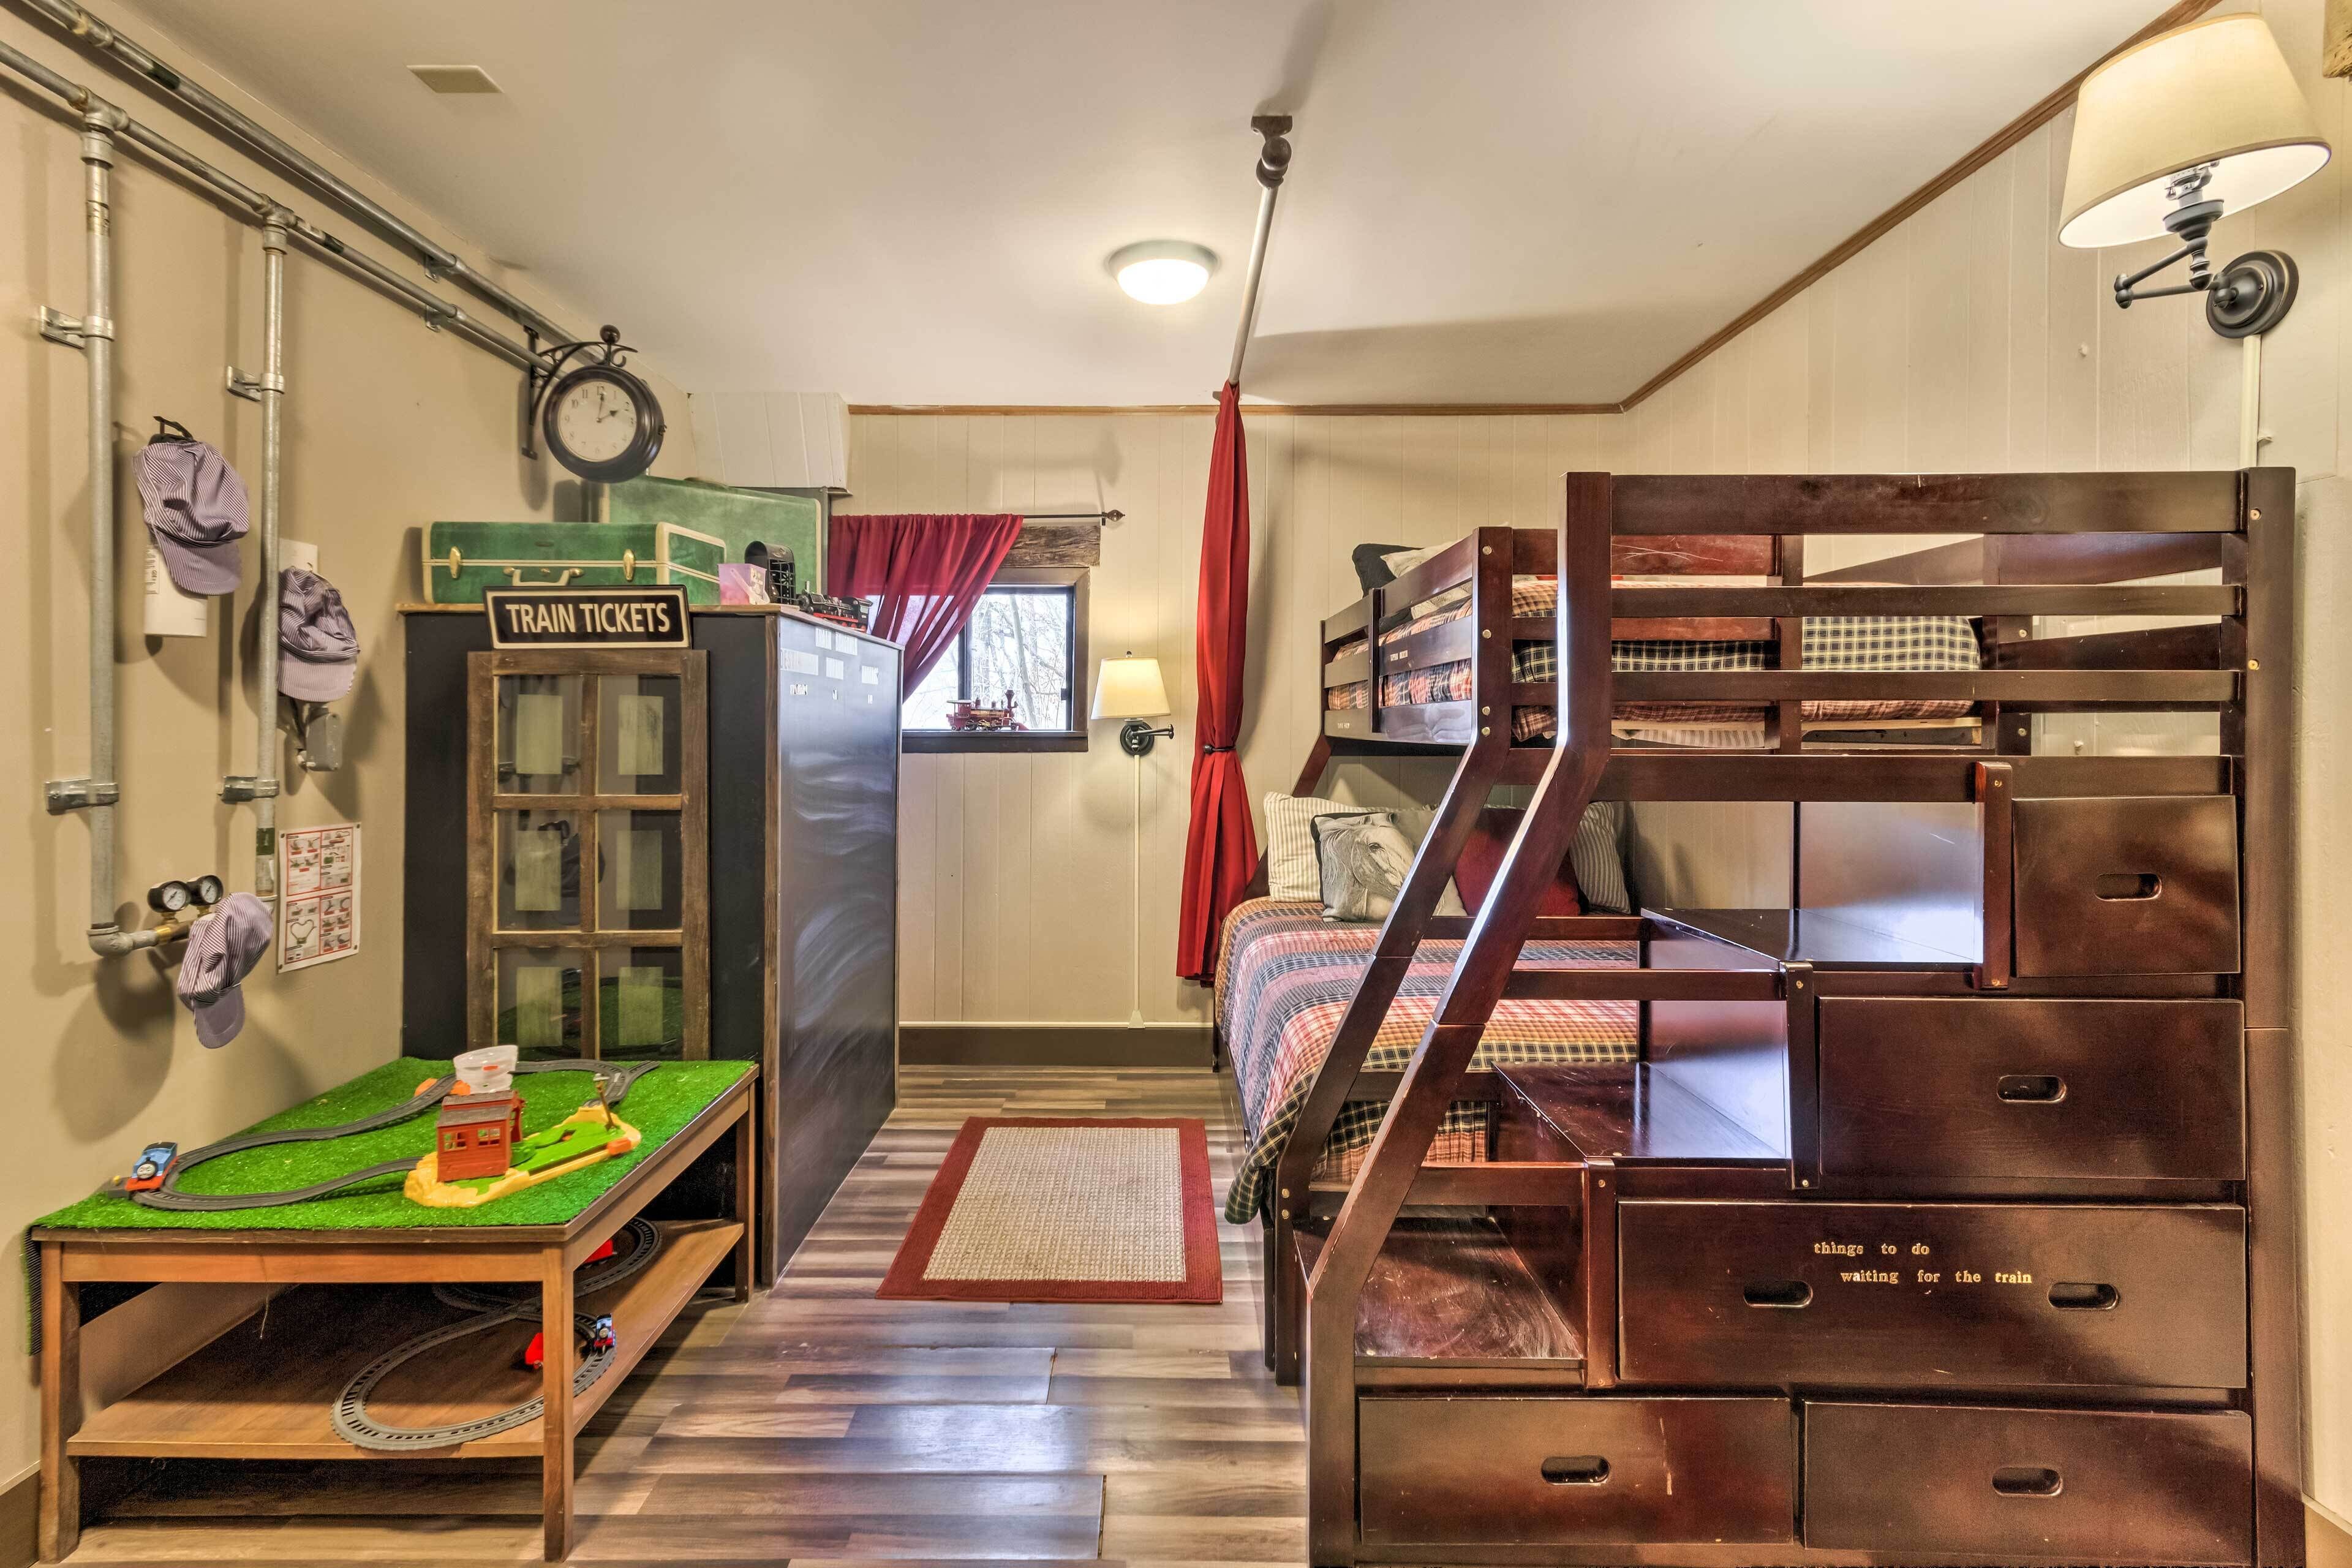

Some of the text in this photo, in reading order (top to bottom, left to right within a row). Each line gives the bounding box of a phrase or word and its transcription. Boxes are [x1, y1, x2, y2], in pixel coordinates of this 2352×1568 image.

[505, 602, 671, 633] TRAIN TICKETS
[1814, 1242, 1930, 1256] things to do
[1840, 1270, 2033, 1284] waiting for the train
